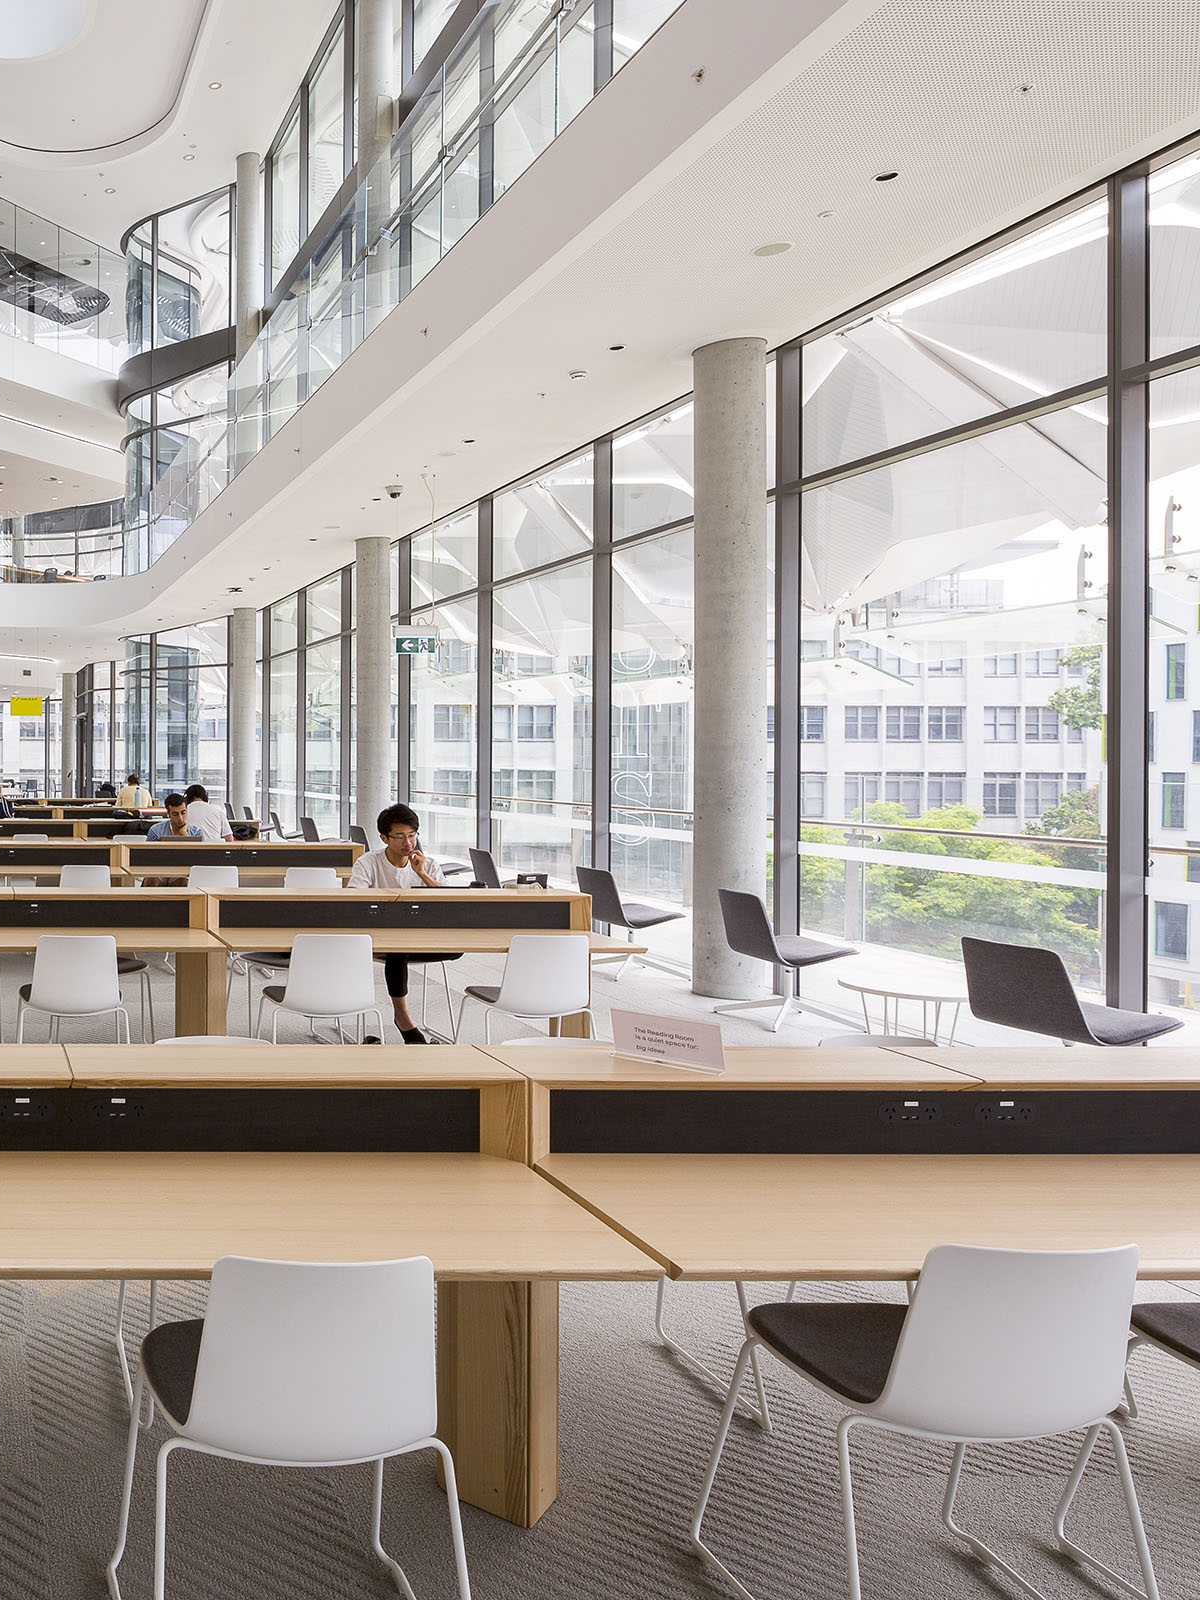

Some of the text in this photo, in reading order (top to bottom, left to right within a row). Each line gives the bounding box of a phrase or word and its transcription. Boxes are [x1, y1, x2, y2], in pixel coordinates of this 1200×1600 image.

[647, 1029, 674, 1039] Reading
[674, 1034, 695, 1042] Room
[665, 1040, 686, 1048] space
